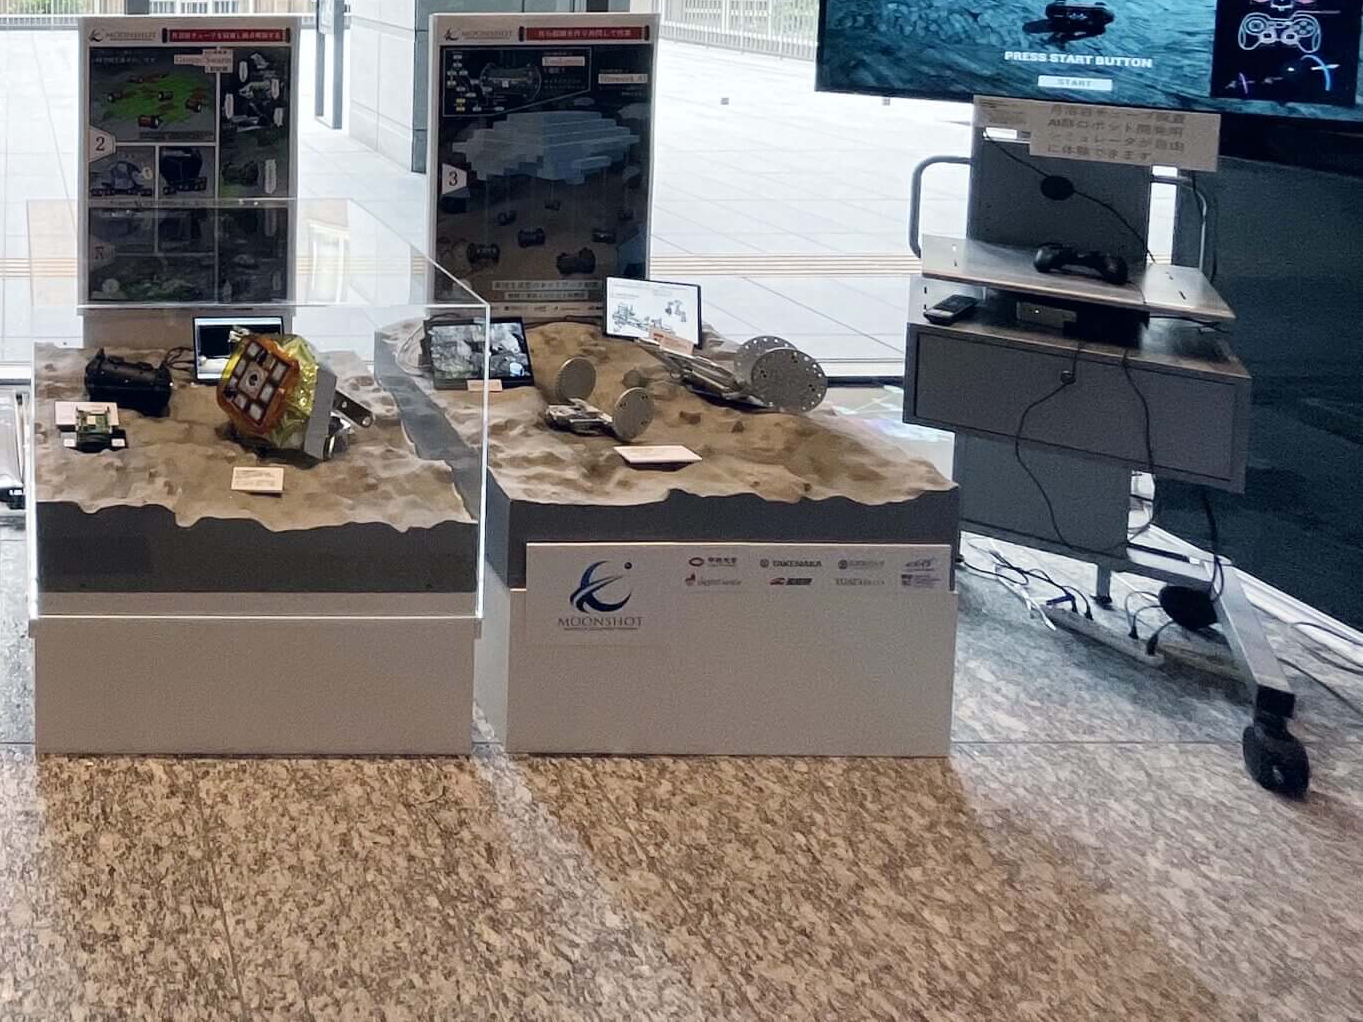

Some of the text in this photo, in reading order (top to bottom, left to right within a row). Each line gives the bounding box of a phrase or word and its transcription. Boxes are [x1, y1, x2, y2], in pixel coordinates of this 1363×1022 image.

[1004, 51, 1153, 68] PRESS START BUTTON
[1058, 77, 1093, 87] START
[95, 136, 106, 152] 2
[448, 171, 459, 187] 3
[557, 616, 646, 627] MOONSHOT
